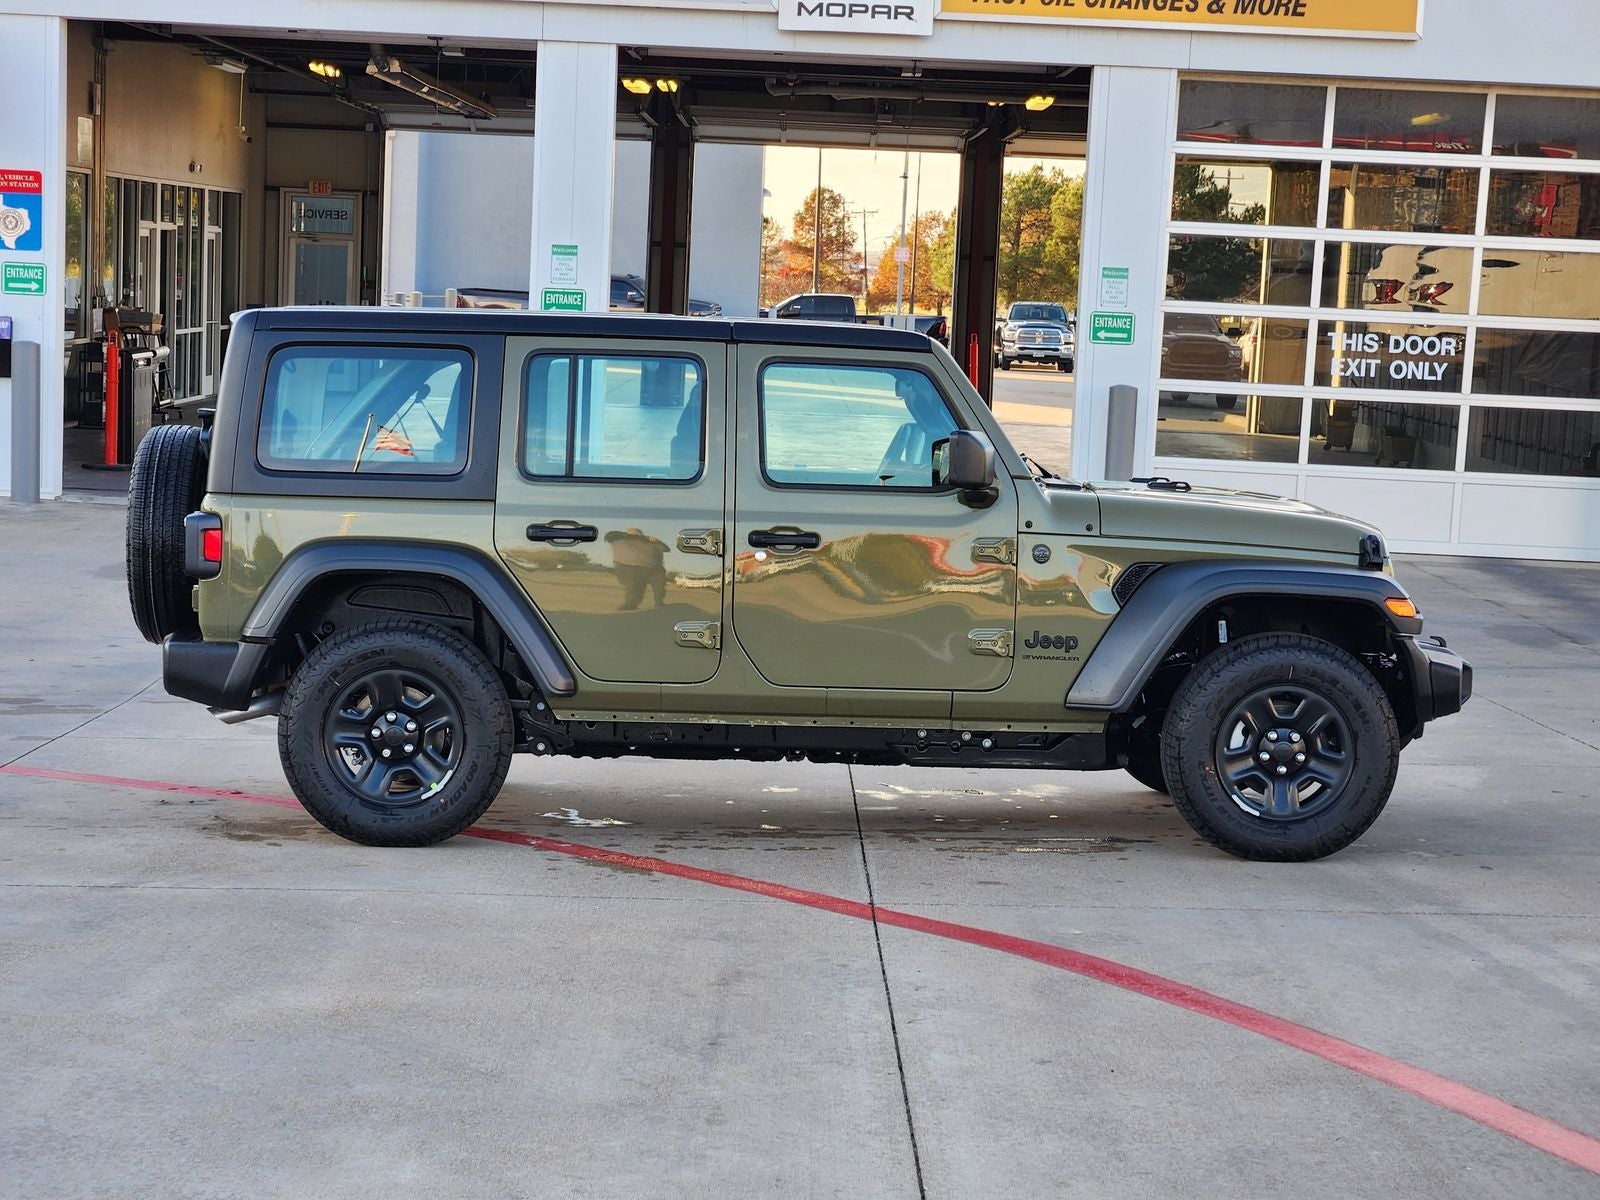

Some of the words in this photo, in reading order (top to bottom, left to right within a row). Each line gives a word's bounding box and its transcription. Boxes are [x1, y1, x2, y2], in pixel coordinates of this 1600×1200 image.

[797, 2, 914, 21] MOPAR
[1233, 0, 1307, 17] MORE
[312, 182, 328, 194] EXIT
[6, 267, 43, 280] ENTRANCE
[545, 293, 582, 305] ENTRANCE
[1094, 317, 1131, 328] ENTRANCE
[1327, 332, 1379, 353] THIS
[1388, 335, 1456, 356] DOOR
[1330, 357, 1381, 378] EXIT
[1389, 360, 1448, 381] ONLY
[1024, 630, 1079, 653] Jeep
[1031, 654, 1080, 662] WRANGLER
